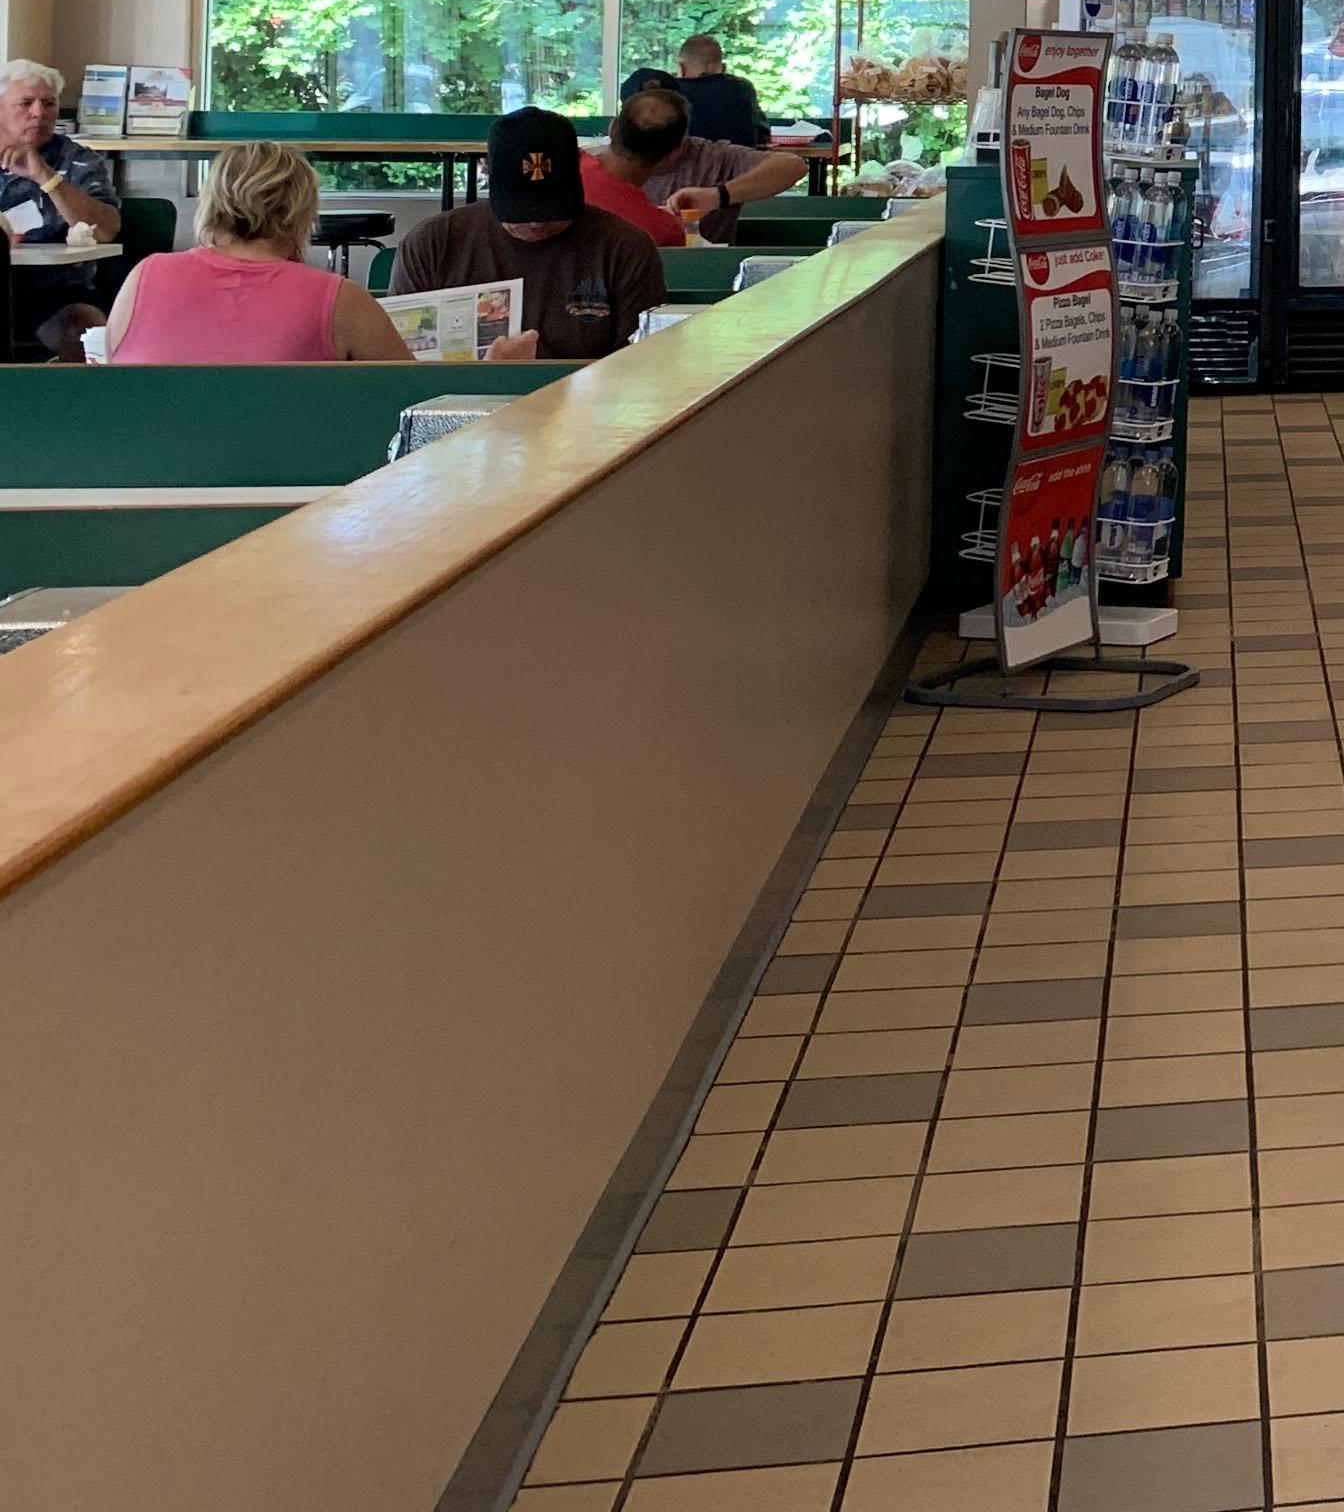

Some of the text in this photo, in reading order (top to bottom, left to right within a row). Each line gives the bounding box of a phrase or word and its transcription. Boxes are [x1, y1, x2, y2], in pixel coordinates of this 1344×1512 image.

[1045, 45, 1099, 58] enjoy together
[1035, 86, 1070, 101] Bagel Dog
[1017, 106, 1030, 120] Any
[1031, 105, 1049, 120] Bagel
[1067, 105, 1085, 119] Chips
[1054, 250, 1104, 267] just add Coke
[1053, 293, 1091, 308] Pizza Bagel
[1088, 312, 1105, 323] Chips
